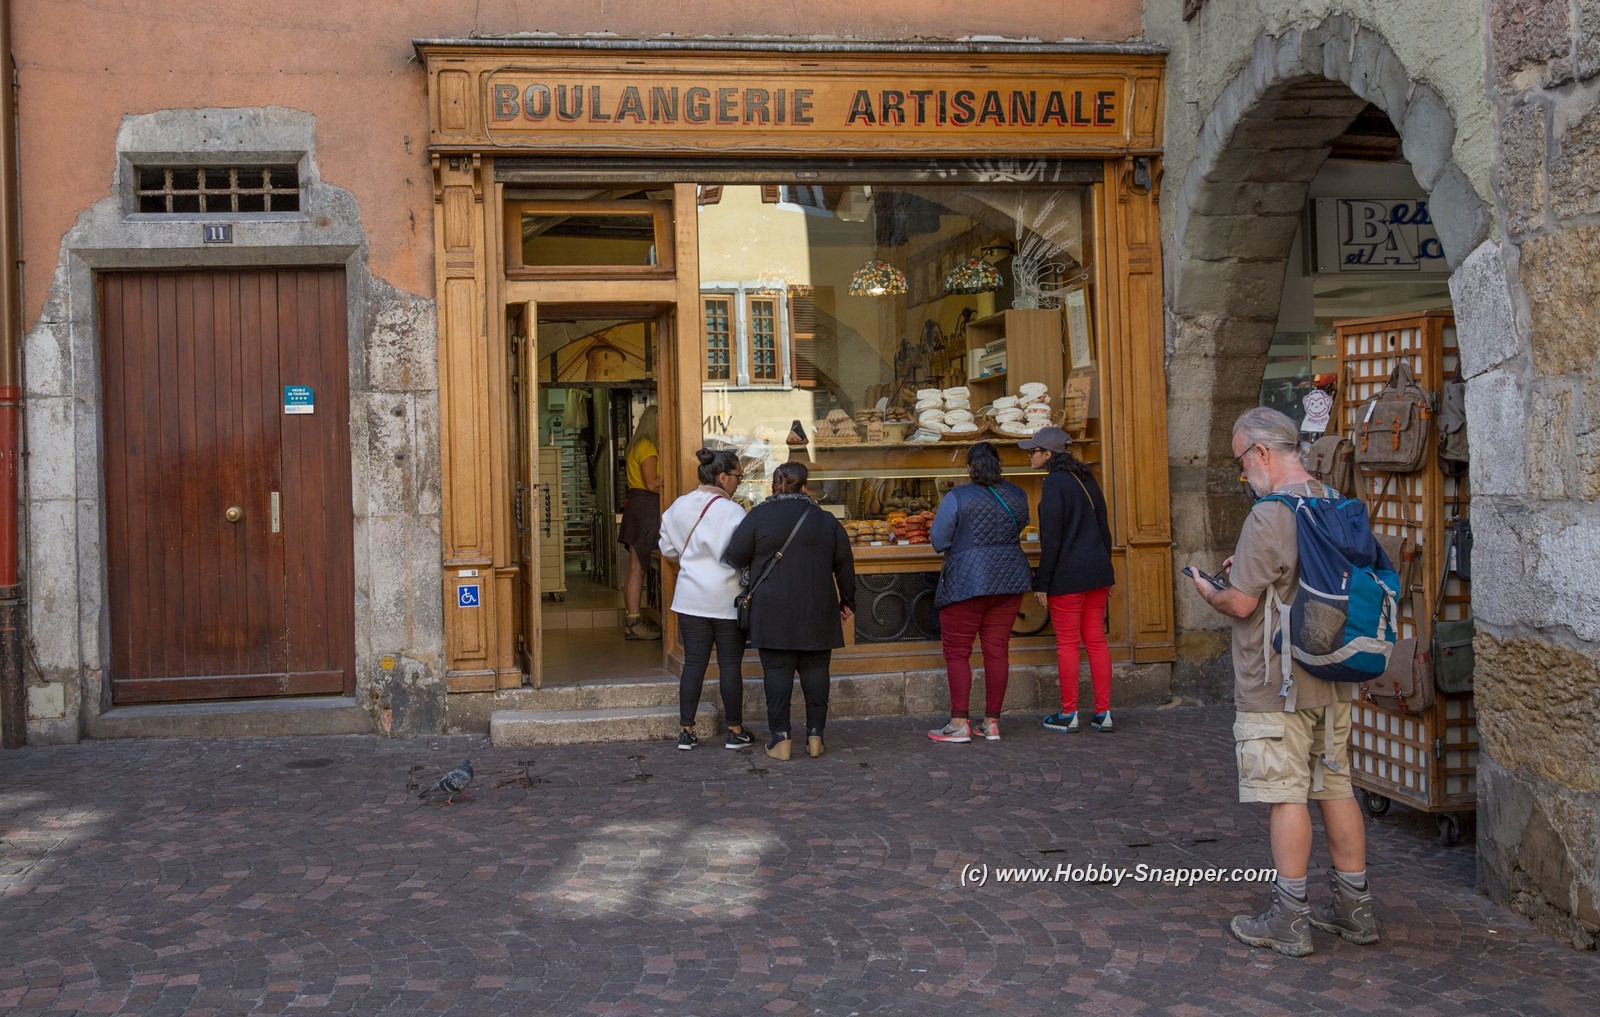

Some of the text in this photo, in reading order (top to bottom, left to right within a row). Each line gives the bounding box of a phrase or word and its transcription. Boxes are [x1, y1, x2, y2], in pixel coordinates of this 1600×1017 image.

[491, 83, 1116, 128] BOULANGERIE ARTISANALE
[211, 227, 225, 240] 11
[1343, 200, 1433, 245] Bes
[1365, 220, 1446, 265] Ac
[1343, 248, 1366, 265] et
